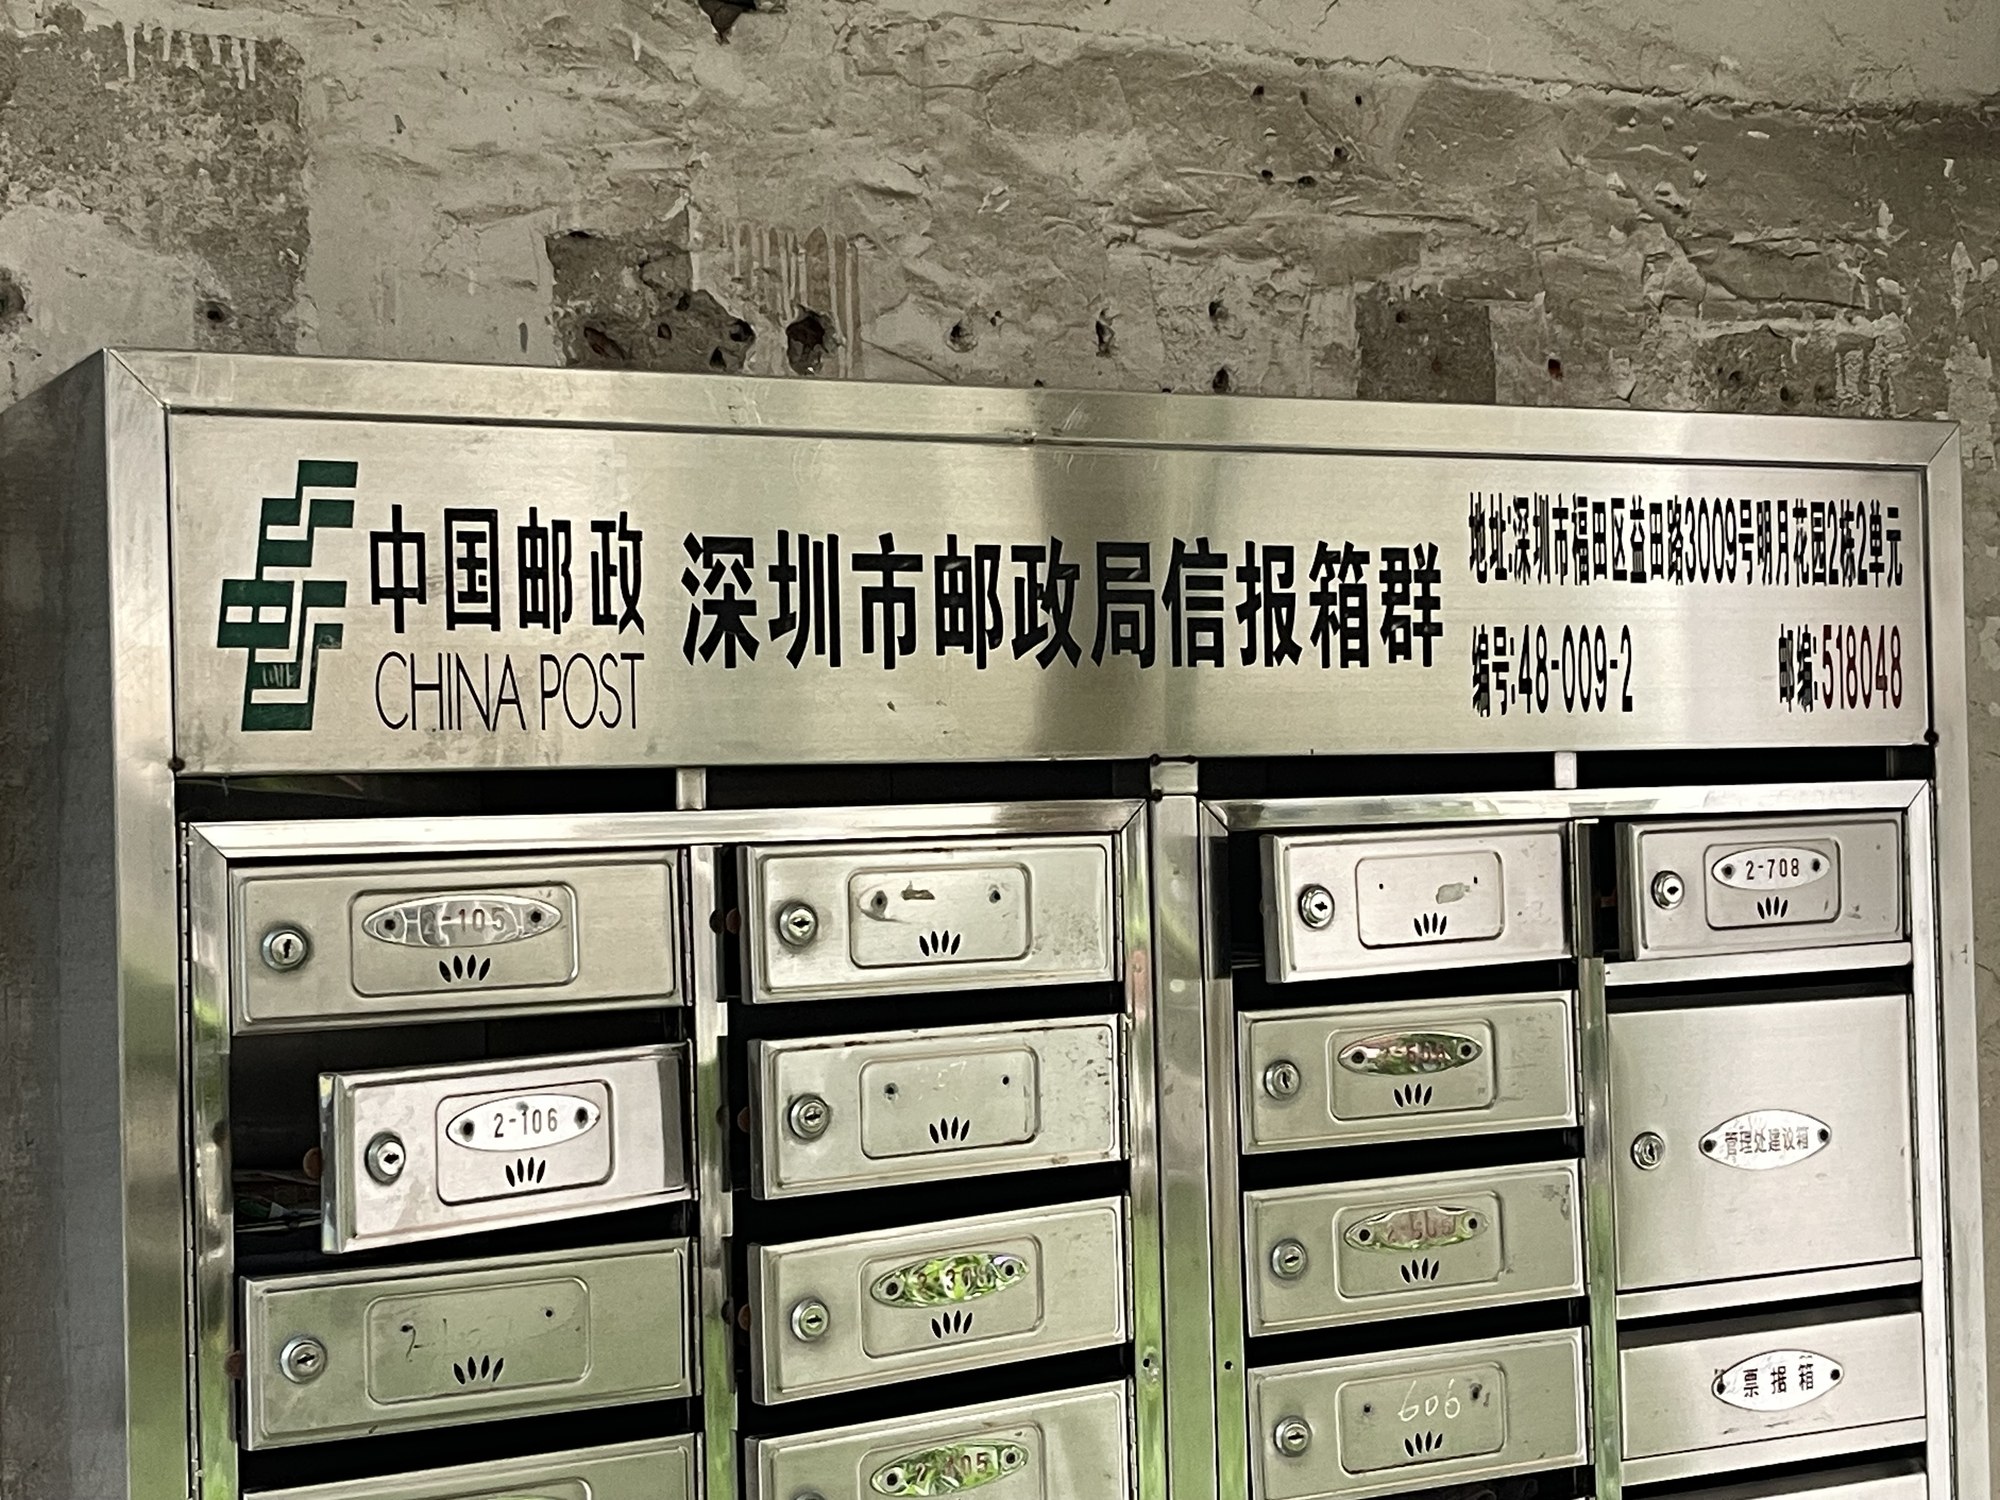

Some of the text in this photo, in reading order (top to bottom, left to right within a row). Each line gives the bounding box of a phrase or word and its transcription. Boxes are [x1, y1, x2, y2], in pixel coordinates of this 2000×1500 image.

[370, 504, 645, 635] 中国邮政
[681, 529, 1443, 670] 深圳市邮政局信报箱群
[375, 651, 645, 731] CHINA POST
[1745, 858, 1800, 880] 2-708
[494, 1107, 558, 1138] 2-106
[1398, 1378, 1461, 1422] 606
